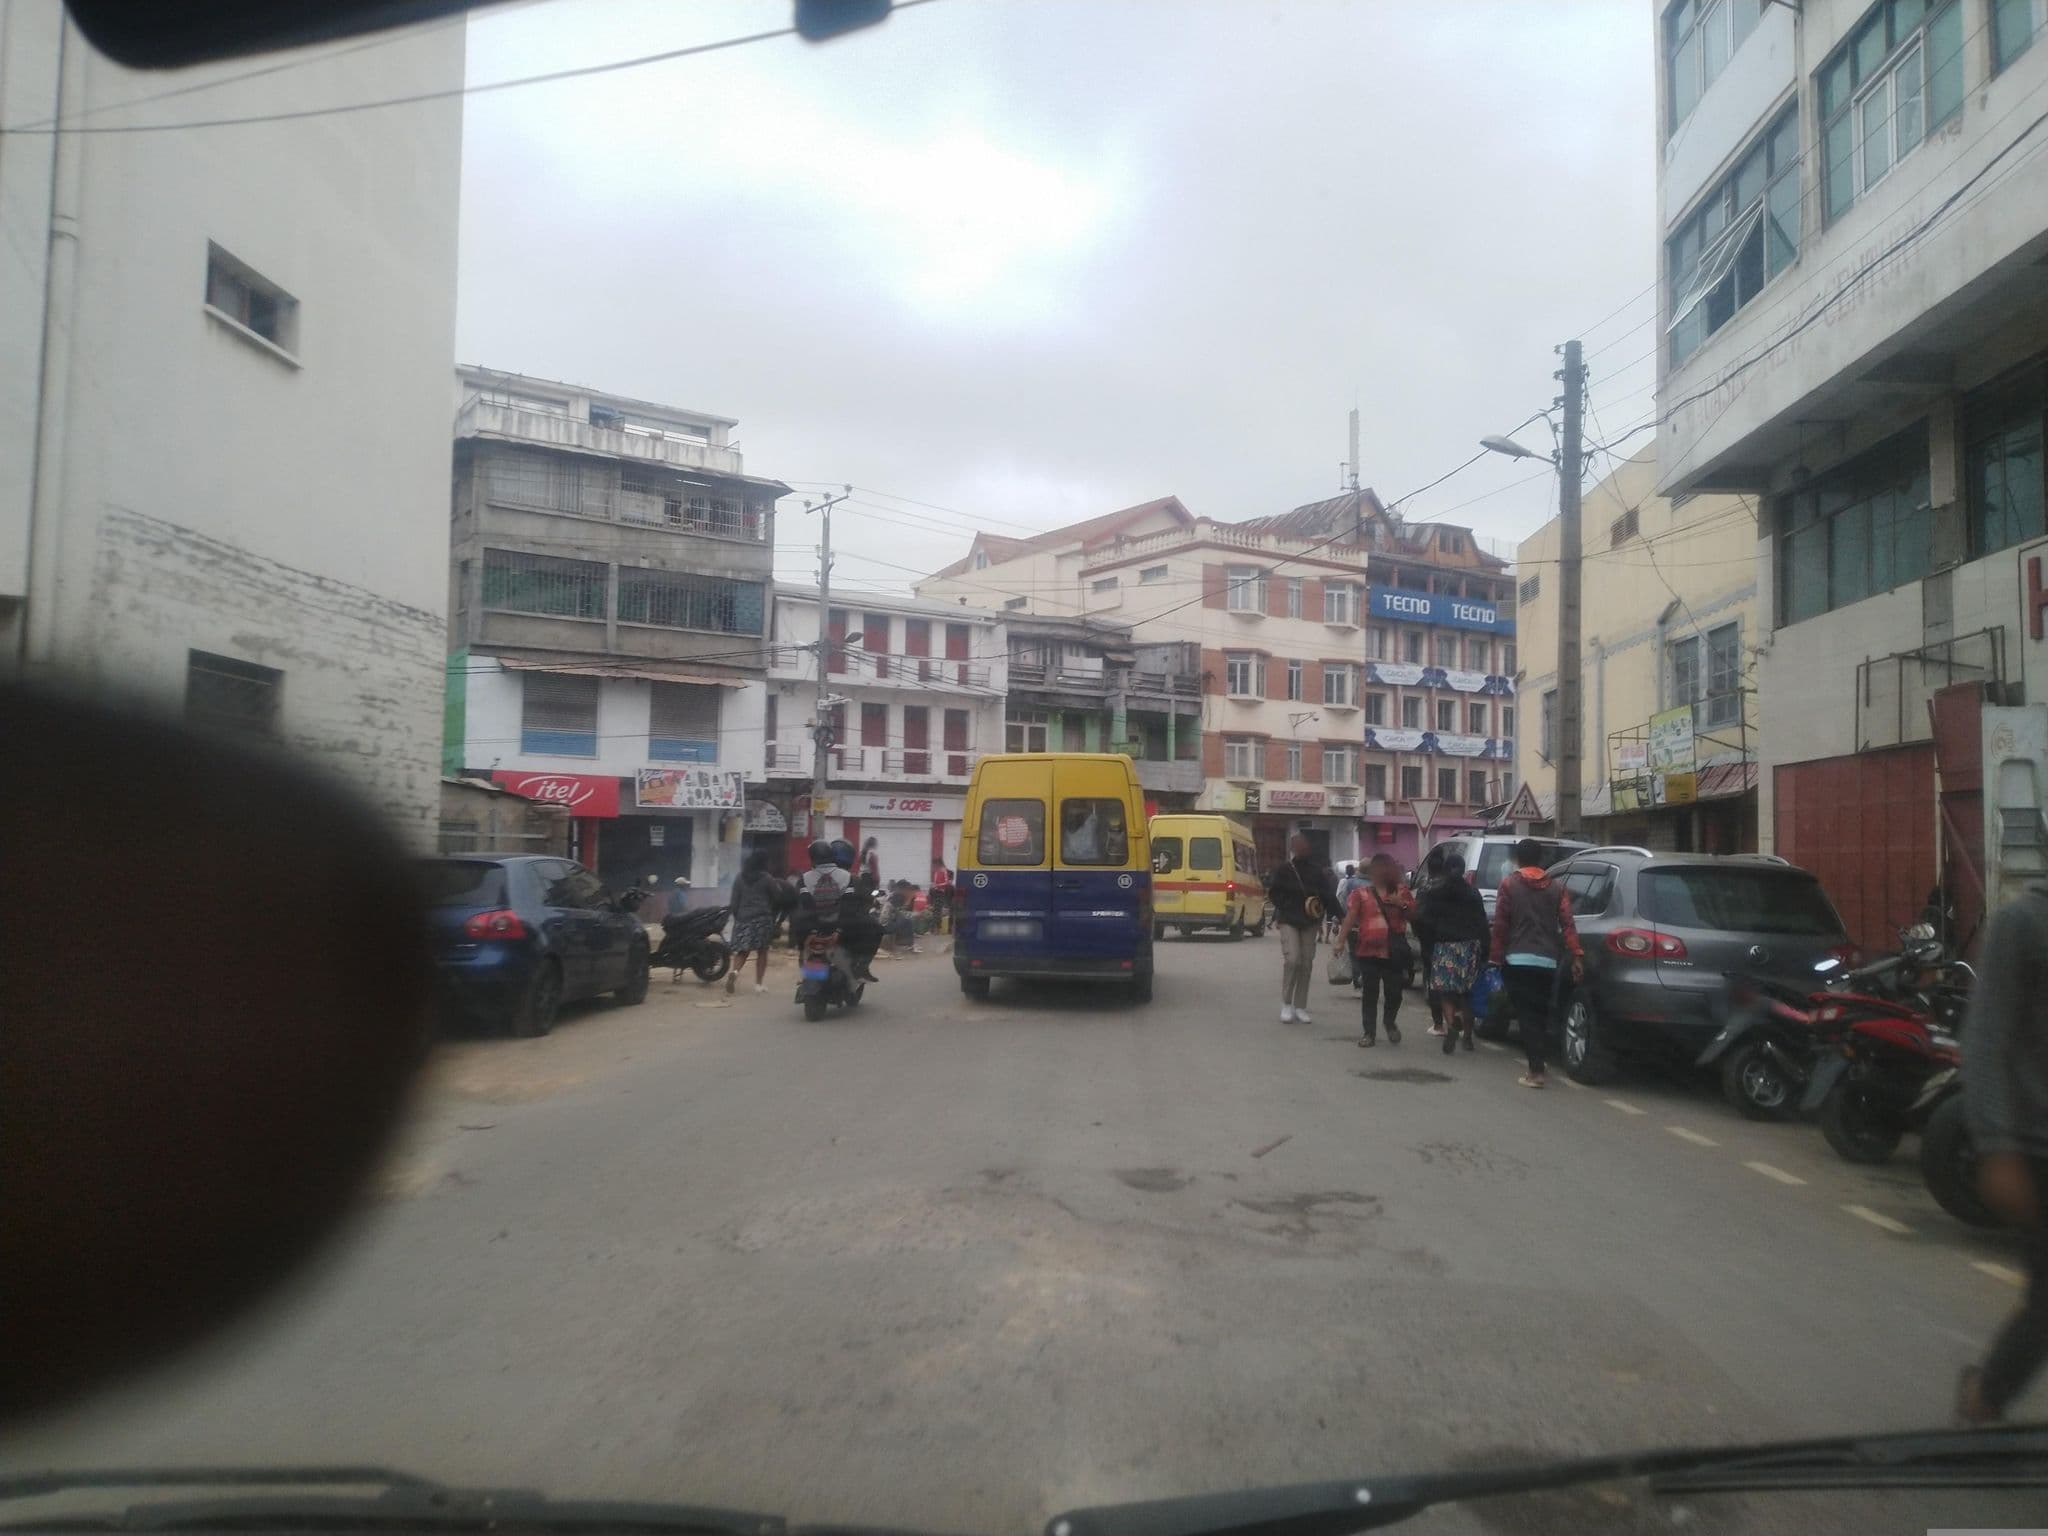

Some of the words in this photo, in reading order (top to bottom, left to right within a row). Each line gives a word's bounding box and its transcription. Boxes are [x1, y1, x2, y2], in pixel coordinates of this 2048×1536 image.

[1383, 594, 1430, 614] TECNO
[1452, 603, 1495, 624] TECNO
[535, 781, 580, 799] itel
